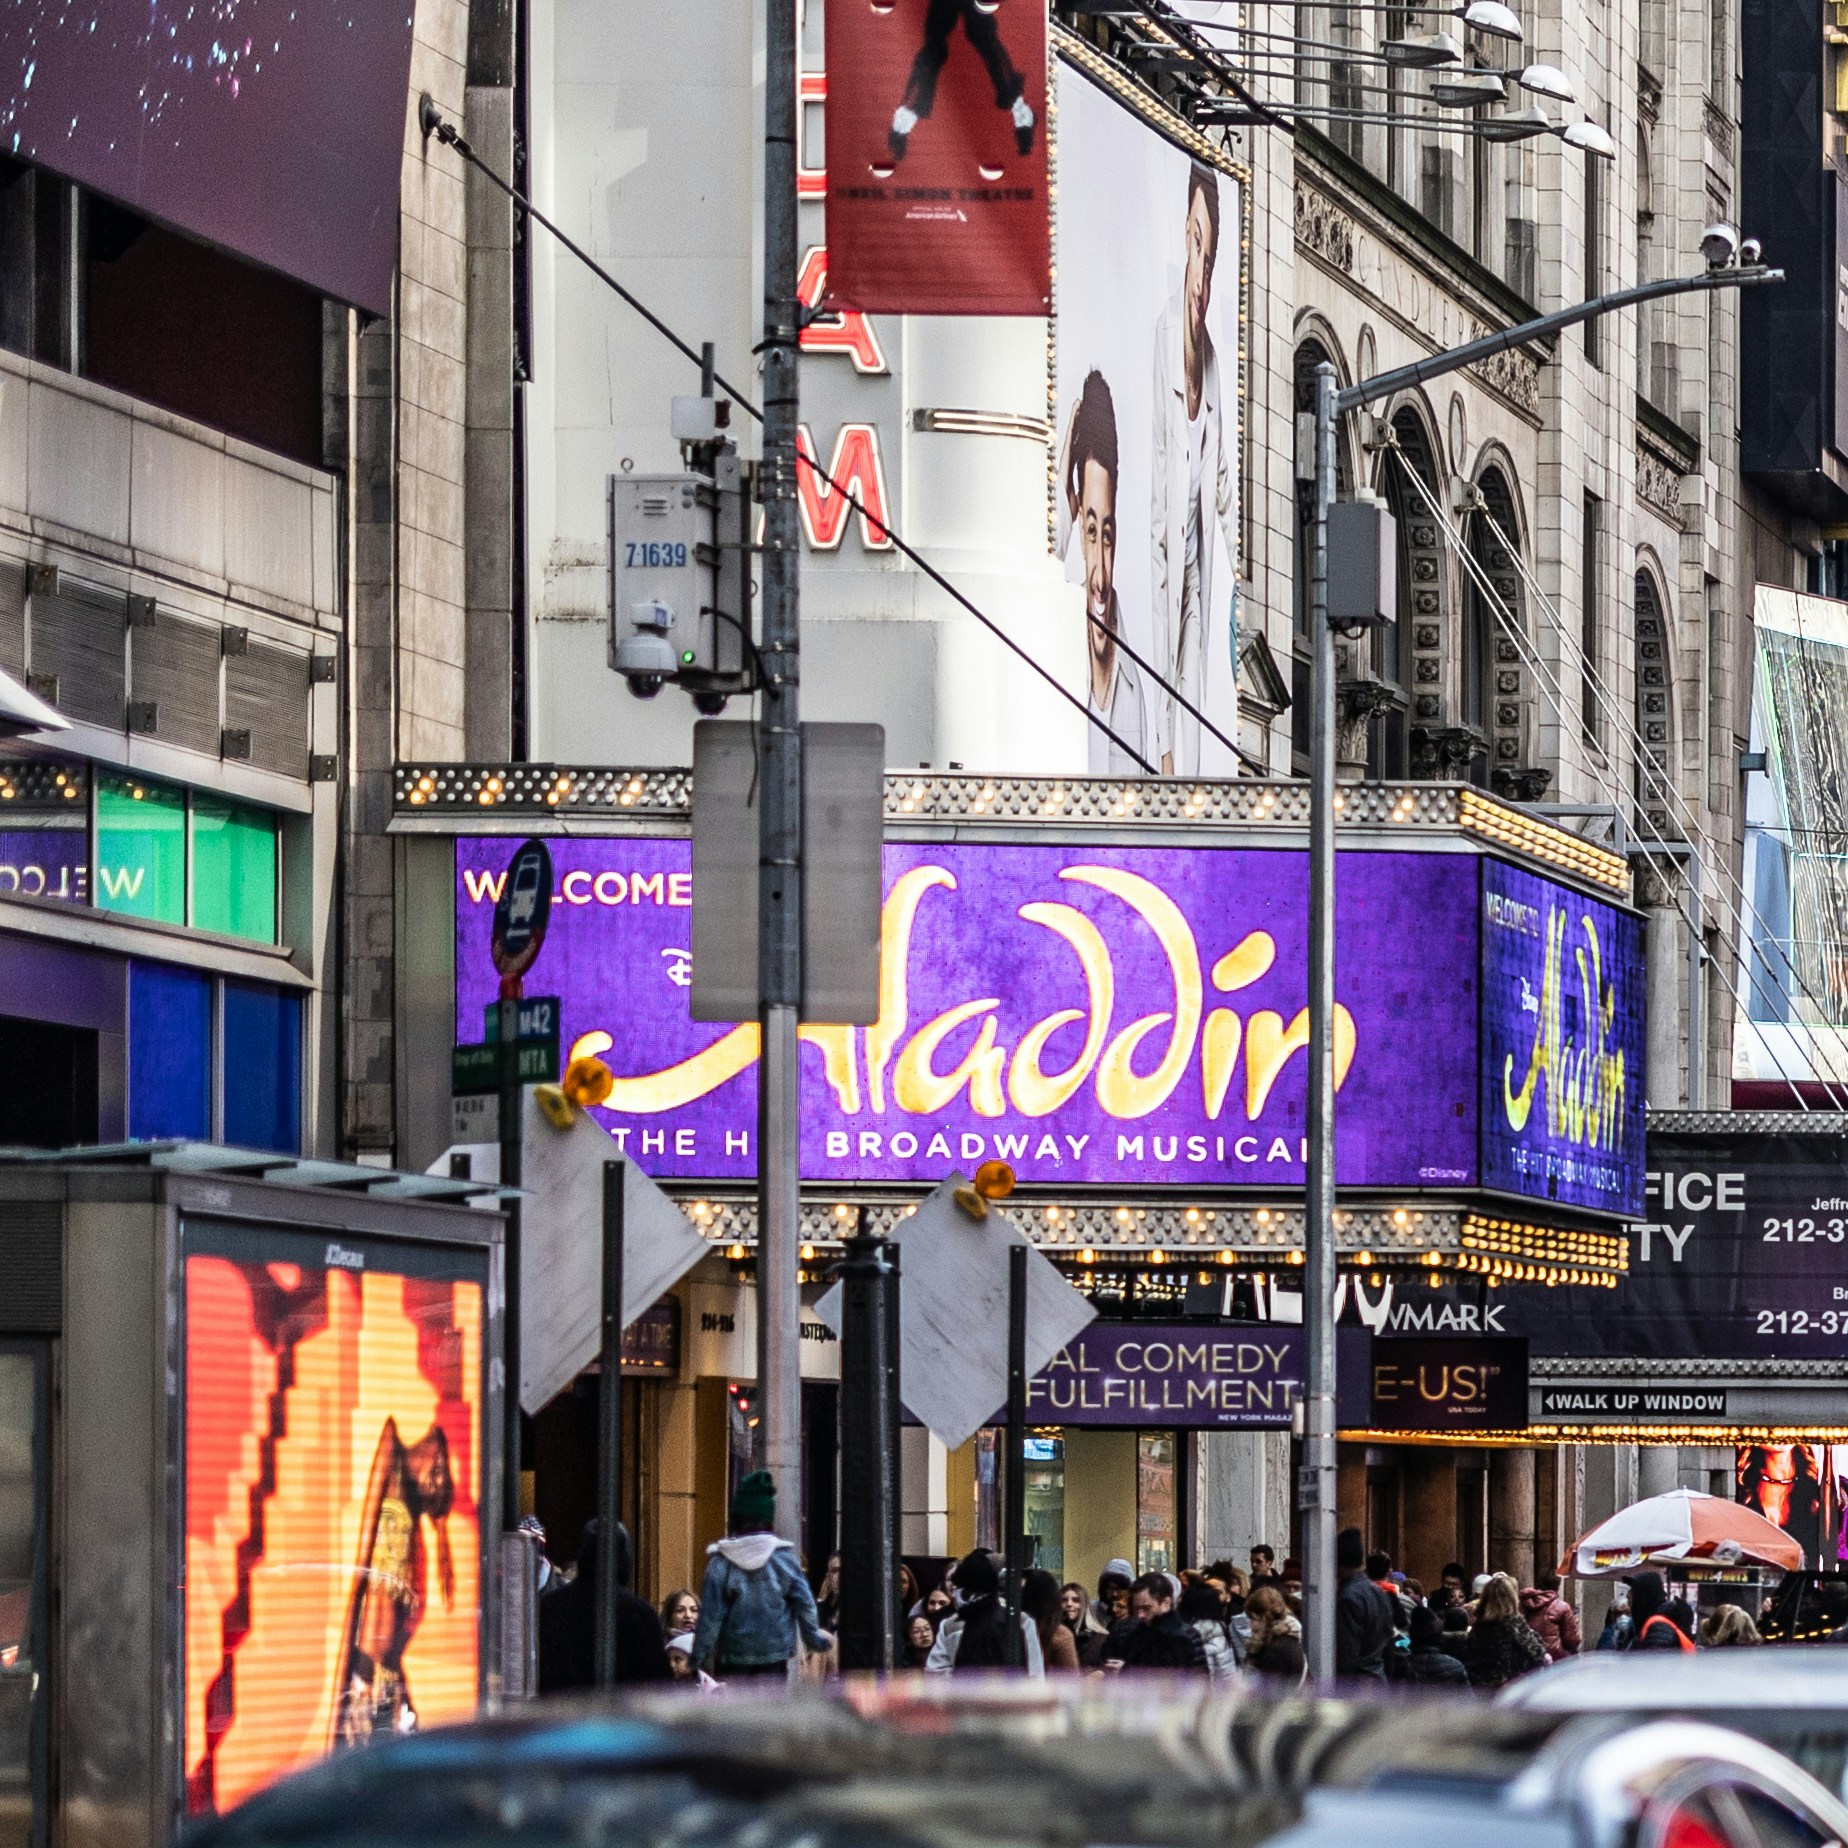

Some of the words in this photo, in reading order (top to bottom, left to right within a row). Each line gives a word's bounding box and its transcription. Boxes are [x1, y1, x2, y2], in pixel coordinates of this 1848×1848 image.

[464, 872, 693, 904] WCOME
[1486, 891, 1528, 934] WELCOME
[617, 1130, 697, 1158] THE
[826, 1131, 1090, 1161] BROADWAY
[1645, 1172, 1746, 1212] FICE
[1388, 1304, 1506, 1332] WMARK
[1116, 1343, 1291, 1374] COMEDY
[1556, 1393, 1608, 1411] WALK
[1614, 1393, 1640, 1411] UP
[1644, 1393, 1725, 1411] WINDOW
[1218, 1414, 1238, 1422] NEW
[1240, 1414, 1262, 1422] YORK
